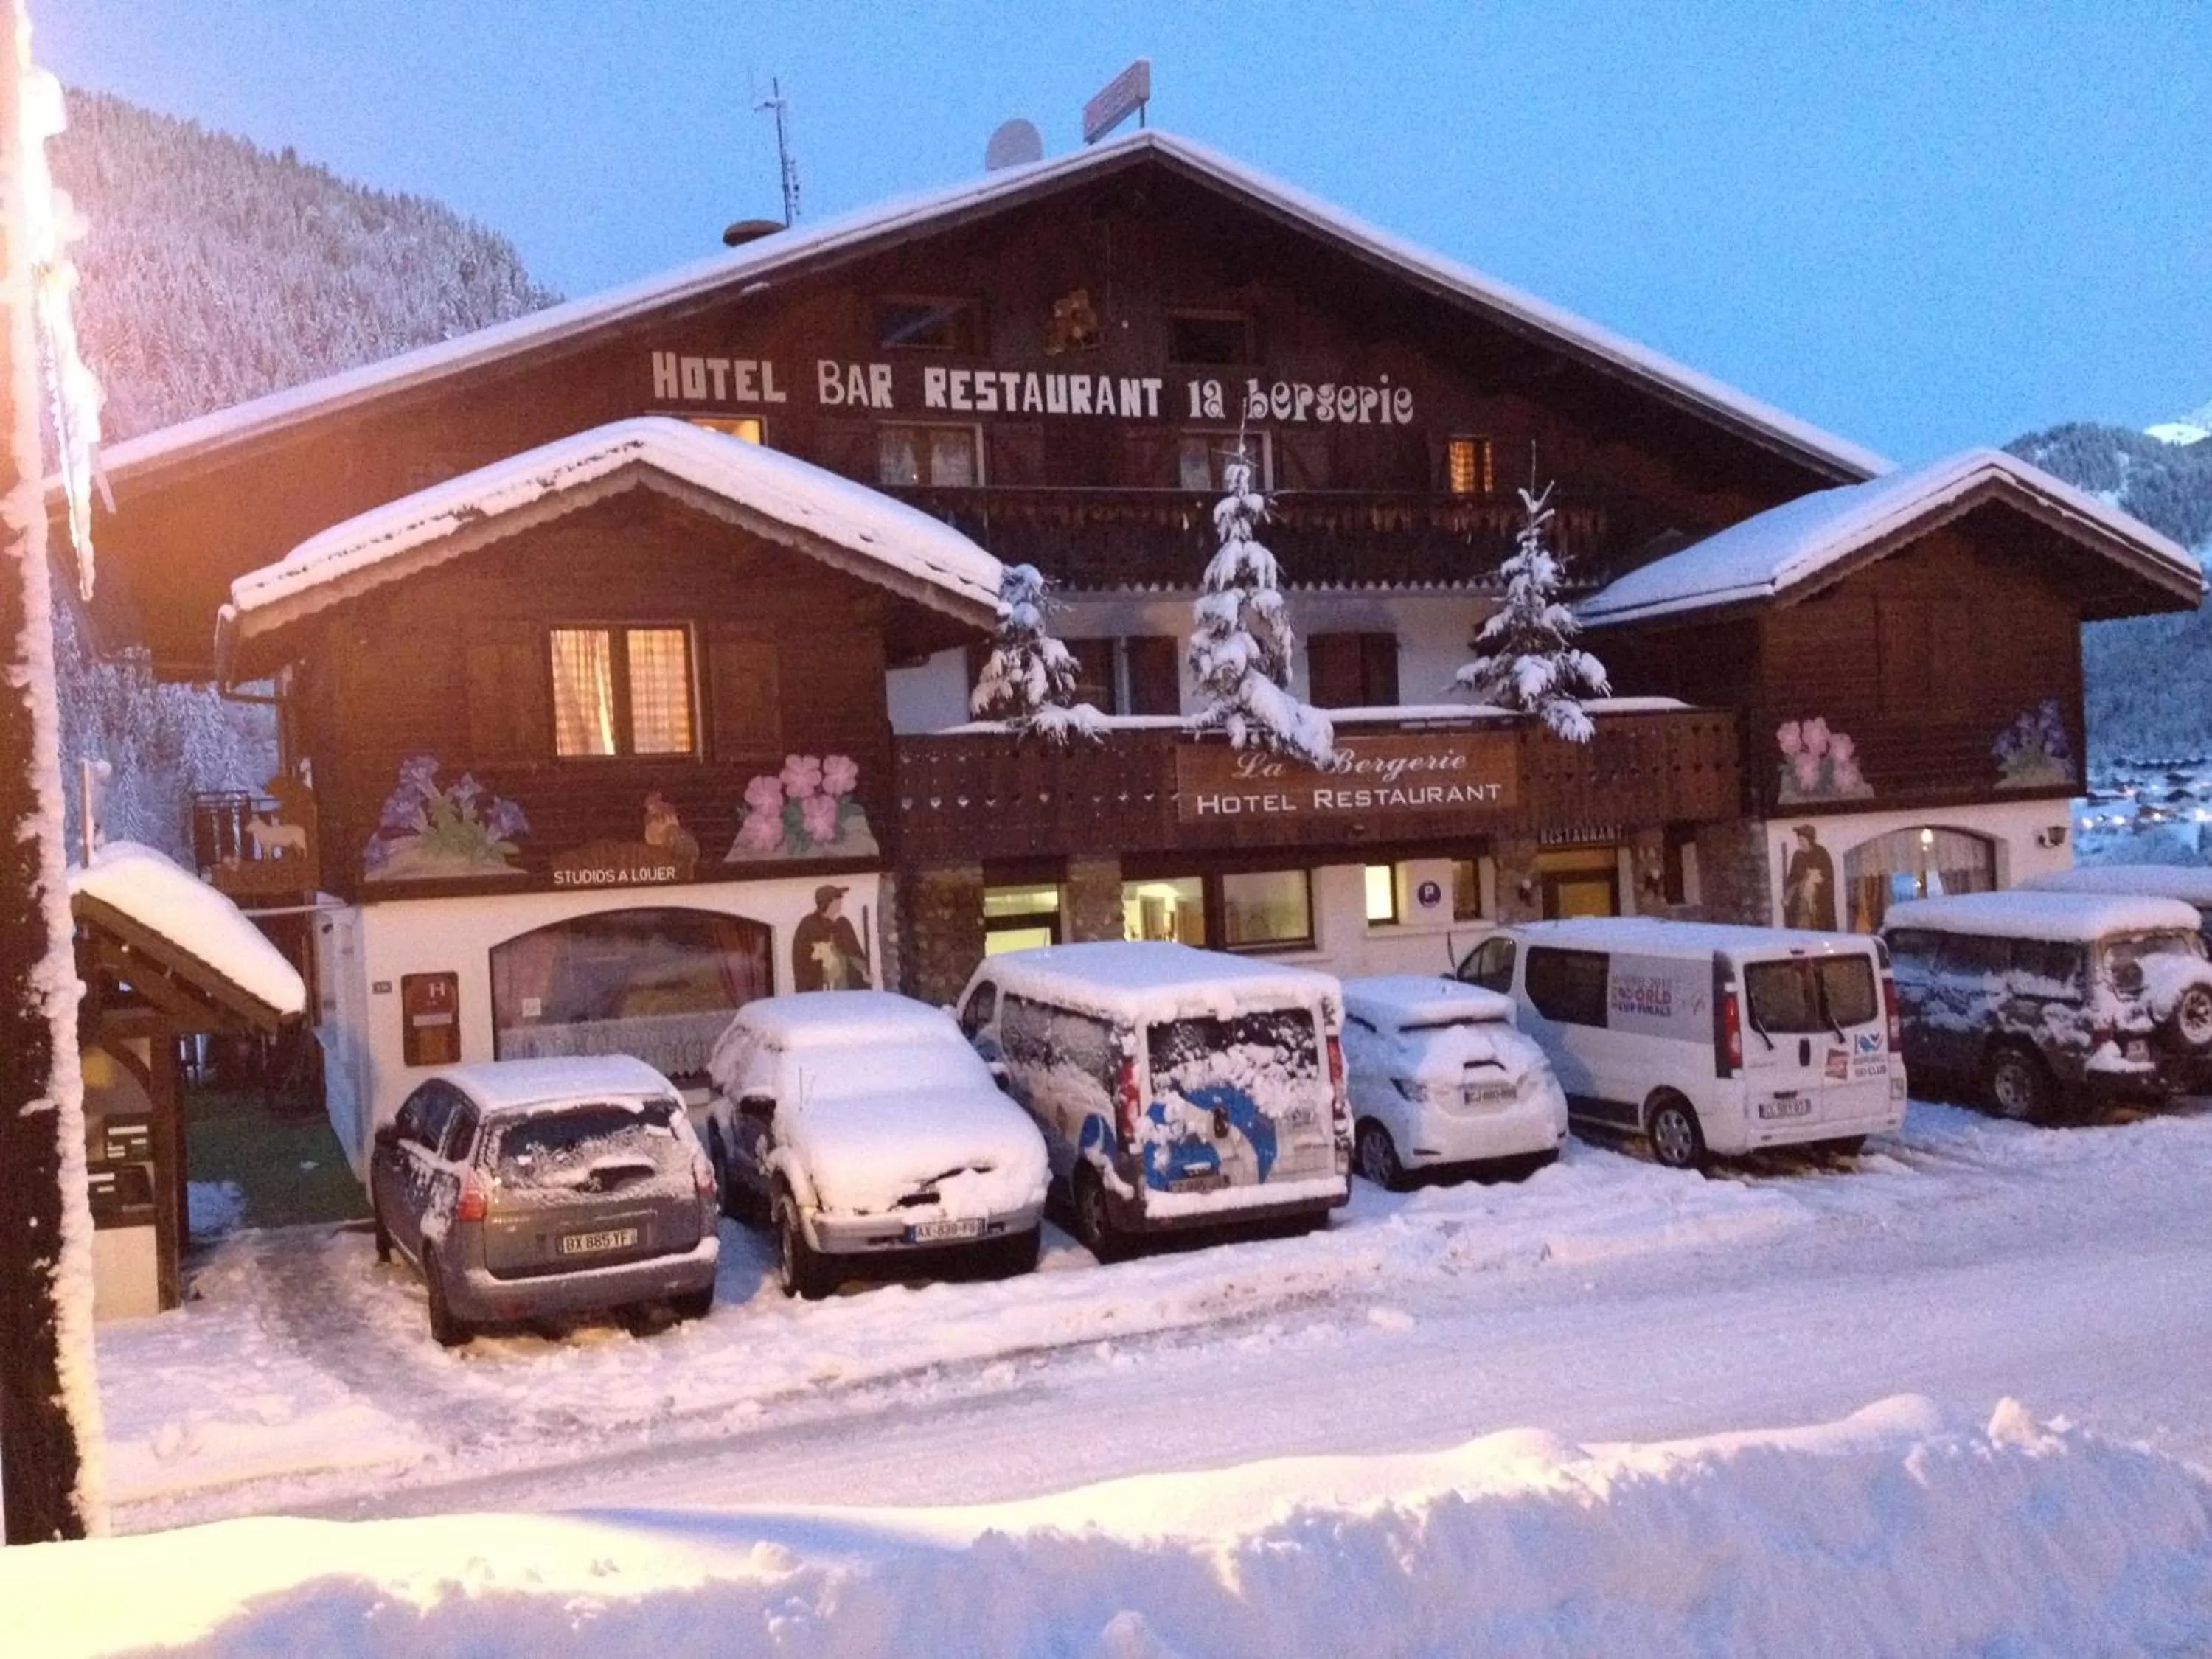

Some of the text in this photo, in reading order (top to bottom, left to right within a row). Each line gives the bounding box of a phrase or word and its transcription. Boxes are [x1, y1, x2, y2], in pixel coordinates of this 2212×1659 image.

[652, 351, 1413, 425] HOTEL BAR RESTAURANT la bergerie
[1231, 748, 1467, 782] La Bergerie
[1197, 783, 1502, 815] HOTEL RESTAURANT
[554, 866, 676, 884] STUDIOS A LOUER
